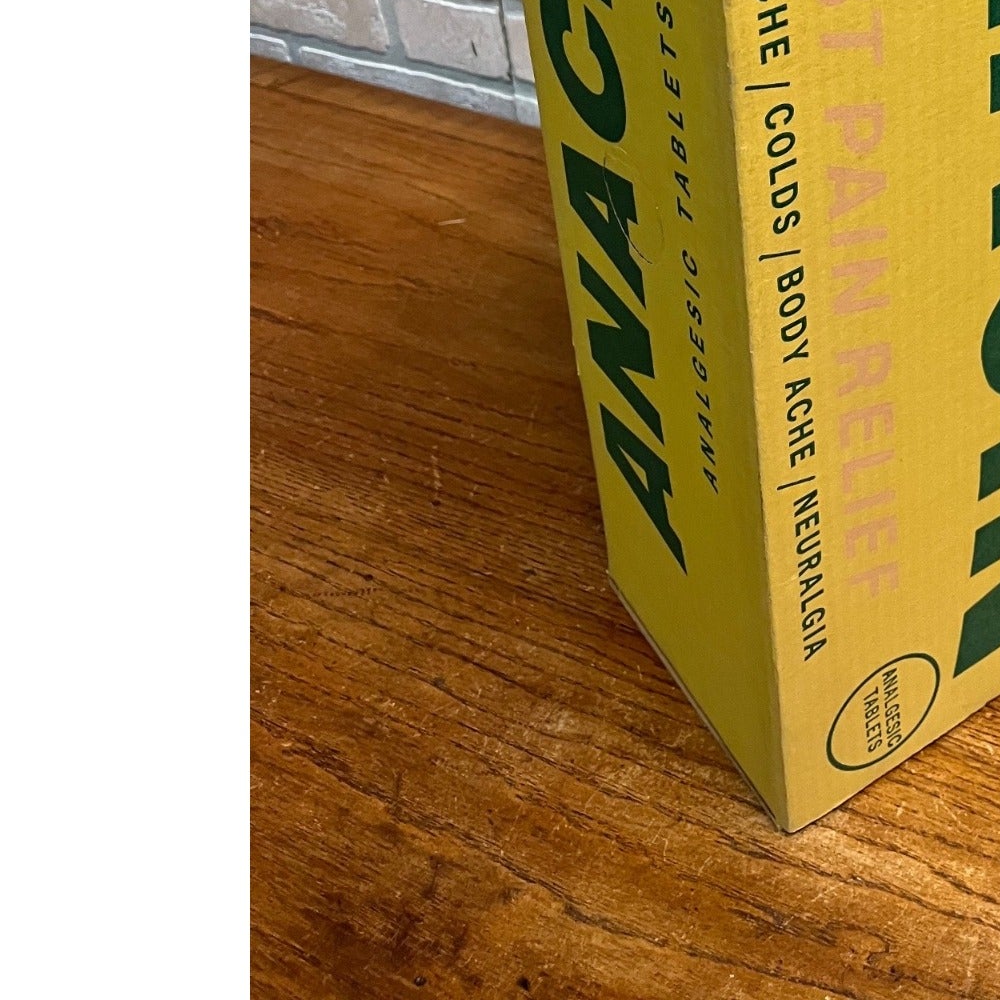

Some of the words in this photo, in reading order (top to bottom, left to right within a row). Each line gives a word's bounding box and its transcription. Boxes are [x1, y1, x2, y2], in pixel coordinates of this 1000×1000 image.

[656, 1, 694, 222] TABLETS
[764, 103, 801, 235] COLDS
[824, 103, 891, 316] PAIN
[681, 249, 719, 495] ANALGESIC
[776, 265, 809, 364] BODY
[784, 376, 816, 468] ACHE
[835, 341, 900, 599] RELIEF
[793, 488, 828, 662] NEURALGIA
[863, 686, 883, 753] TABLETS
[882, 667, 903, 749] ANALGESIC
